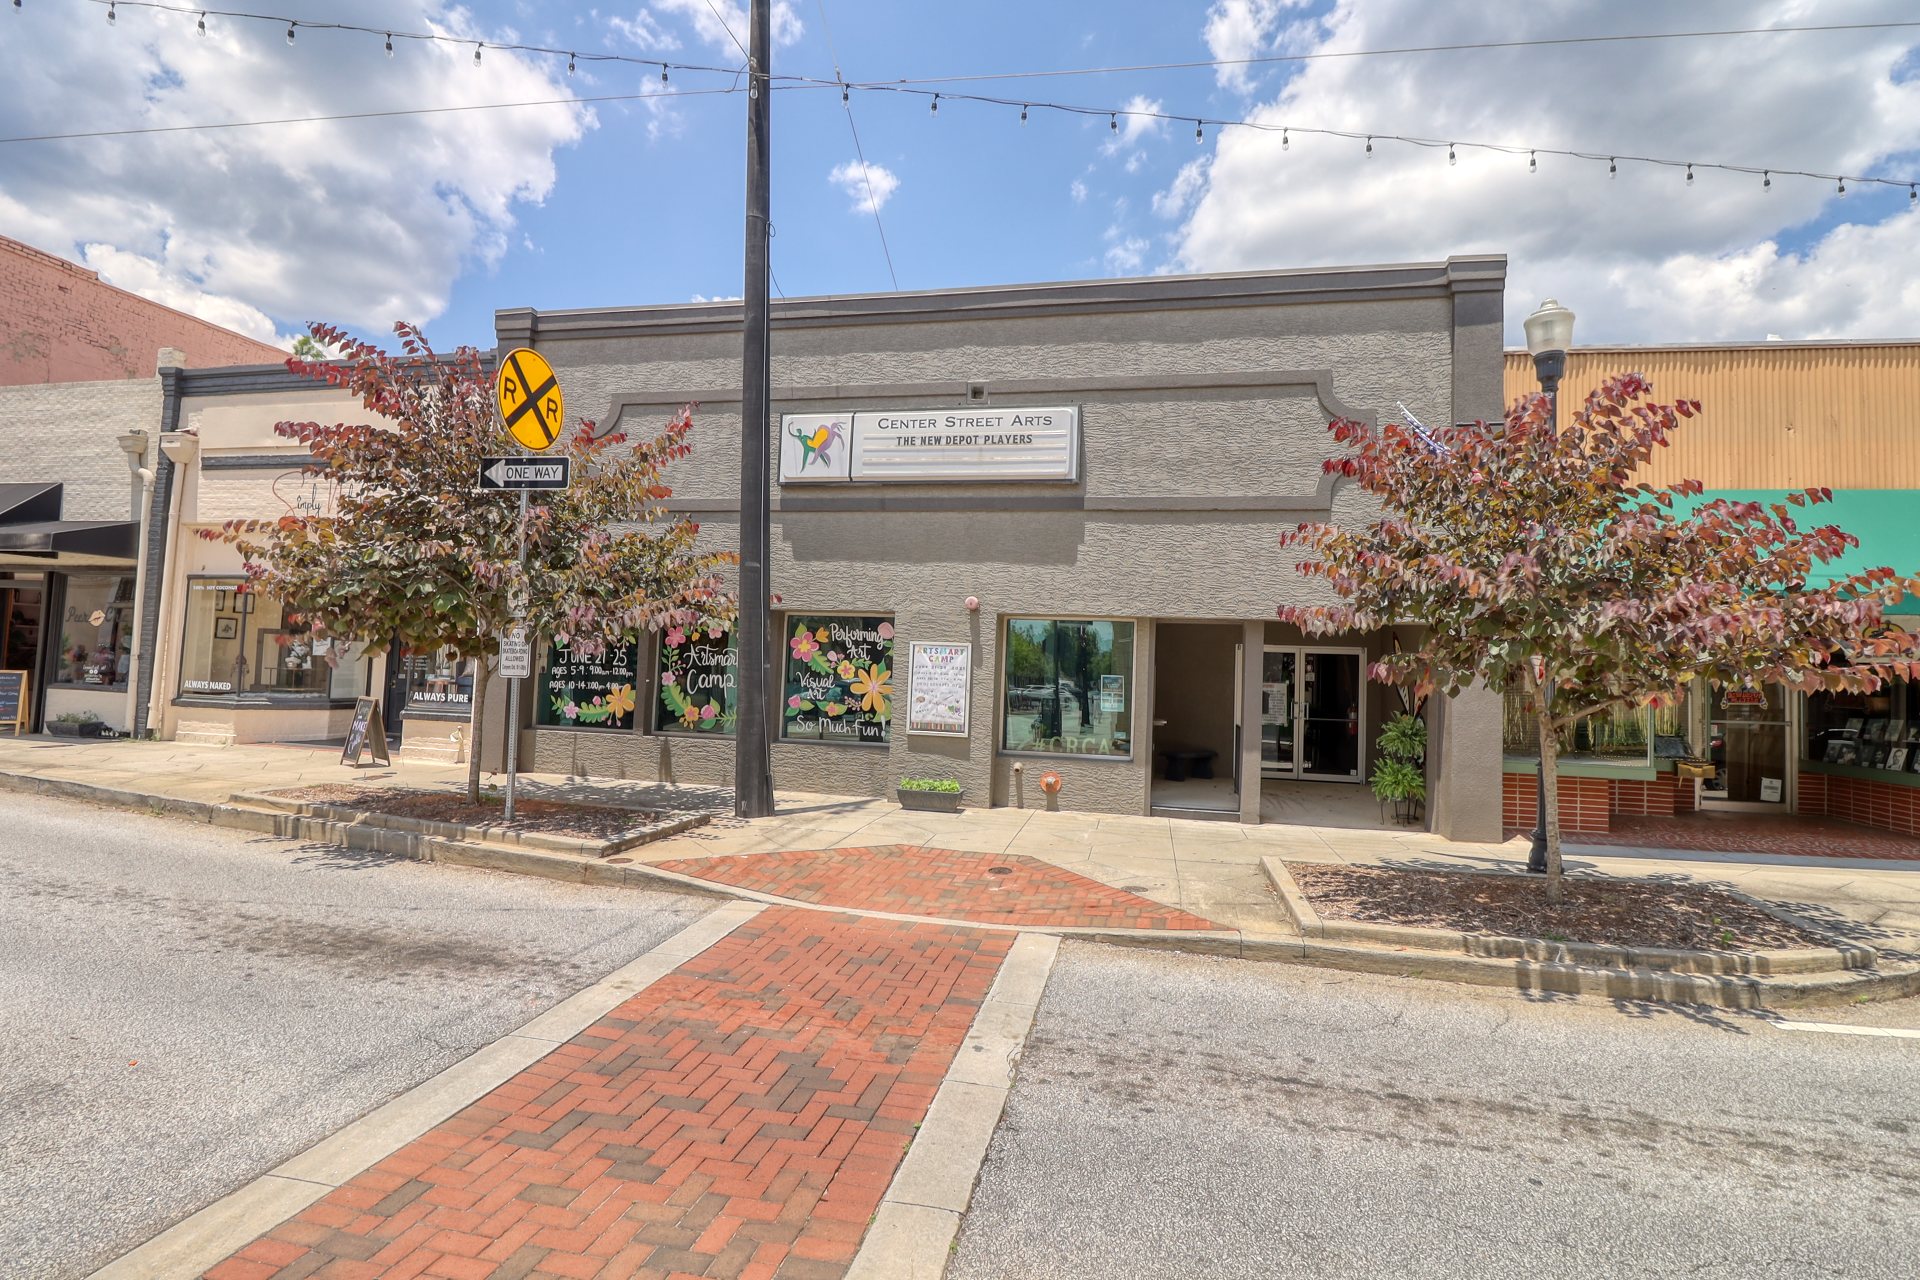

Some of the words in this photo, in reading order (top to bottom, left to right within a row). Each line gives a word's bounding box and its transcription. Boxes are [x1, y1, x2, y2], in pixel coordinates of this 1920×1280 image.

[504, 377, 517, 404] R
[546, 397, 559, 423] R
[877, 418, 937, 430] CENTER
[944, 415, 1004, 428] STREET
[1011, 414, 1053, 427] ARTS
[896, 436, 916, 446] THE
[920, 435, 942, 445] NEW
[945, 435, 979, 445] DEPOT
[983, 434, 1033, 445] PLAYERS
[506, 467, 530, 479] ONE
[534, 466, 559, 479] WAY
[829, 622, 884, 650] Performing
[683, 643, 739, 669] Artsmart
[846, 643, 872, 660] Art
[916, 647, 965, 656] ARTSMART
[928, 655, 954, 663] CAMP
[551, 666, 568, 679] AGES
[796, 671, 836, 688] Visual
[184, 680, 209, 689] ALWAYS
[210, 681, 231, 690] NAKED
[549, 681, 566, 692] AGES
[686, 669, 737, 699] Camp
[413, 692, 446, 702] ALWAYS
[447, 692, 469, 703] PURE
[807, 688, 826, 700] Art
[796, 715, 816, 732] So
[819, 716, 851, 735] Much
